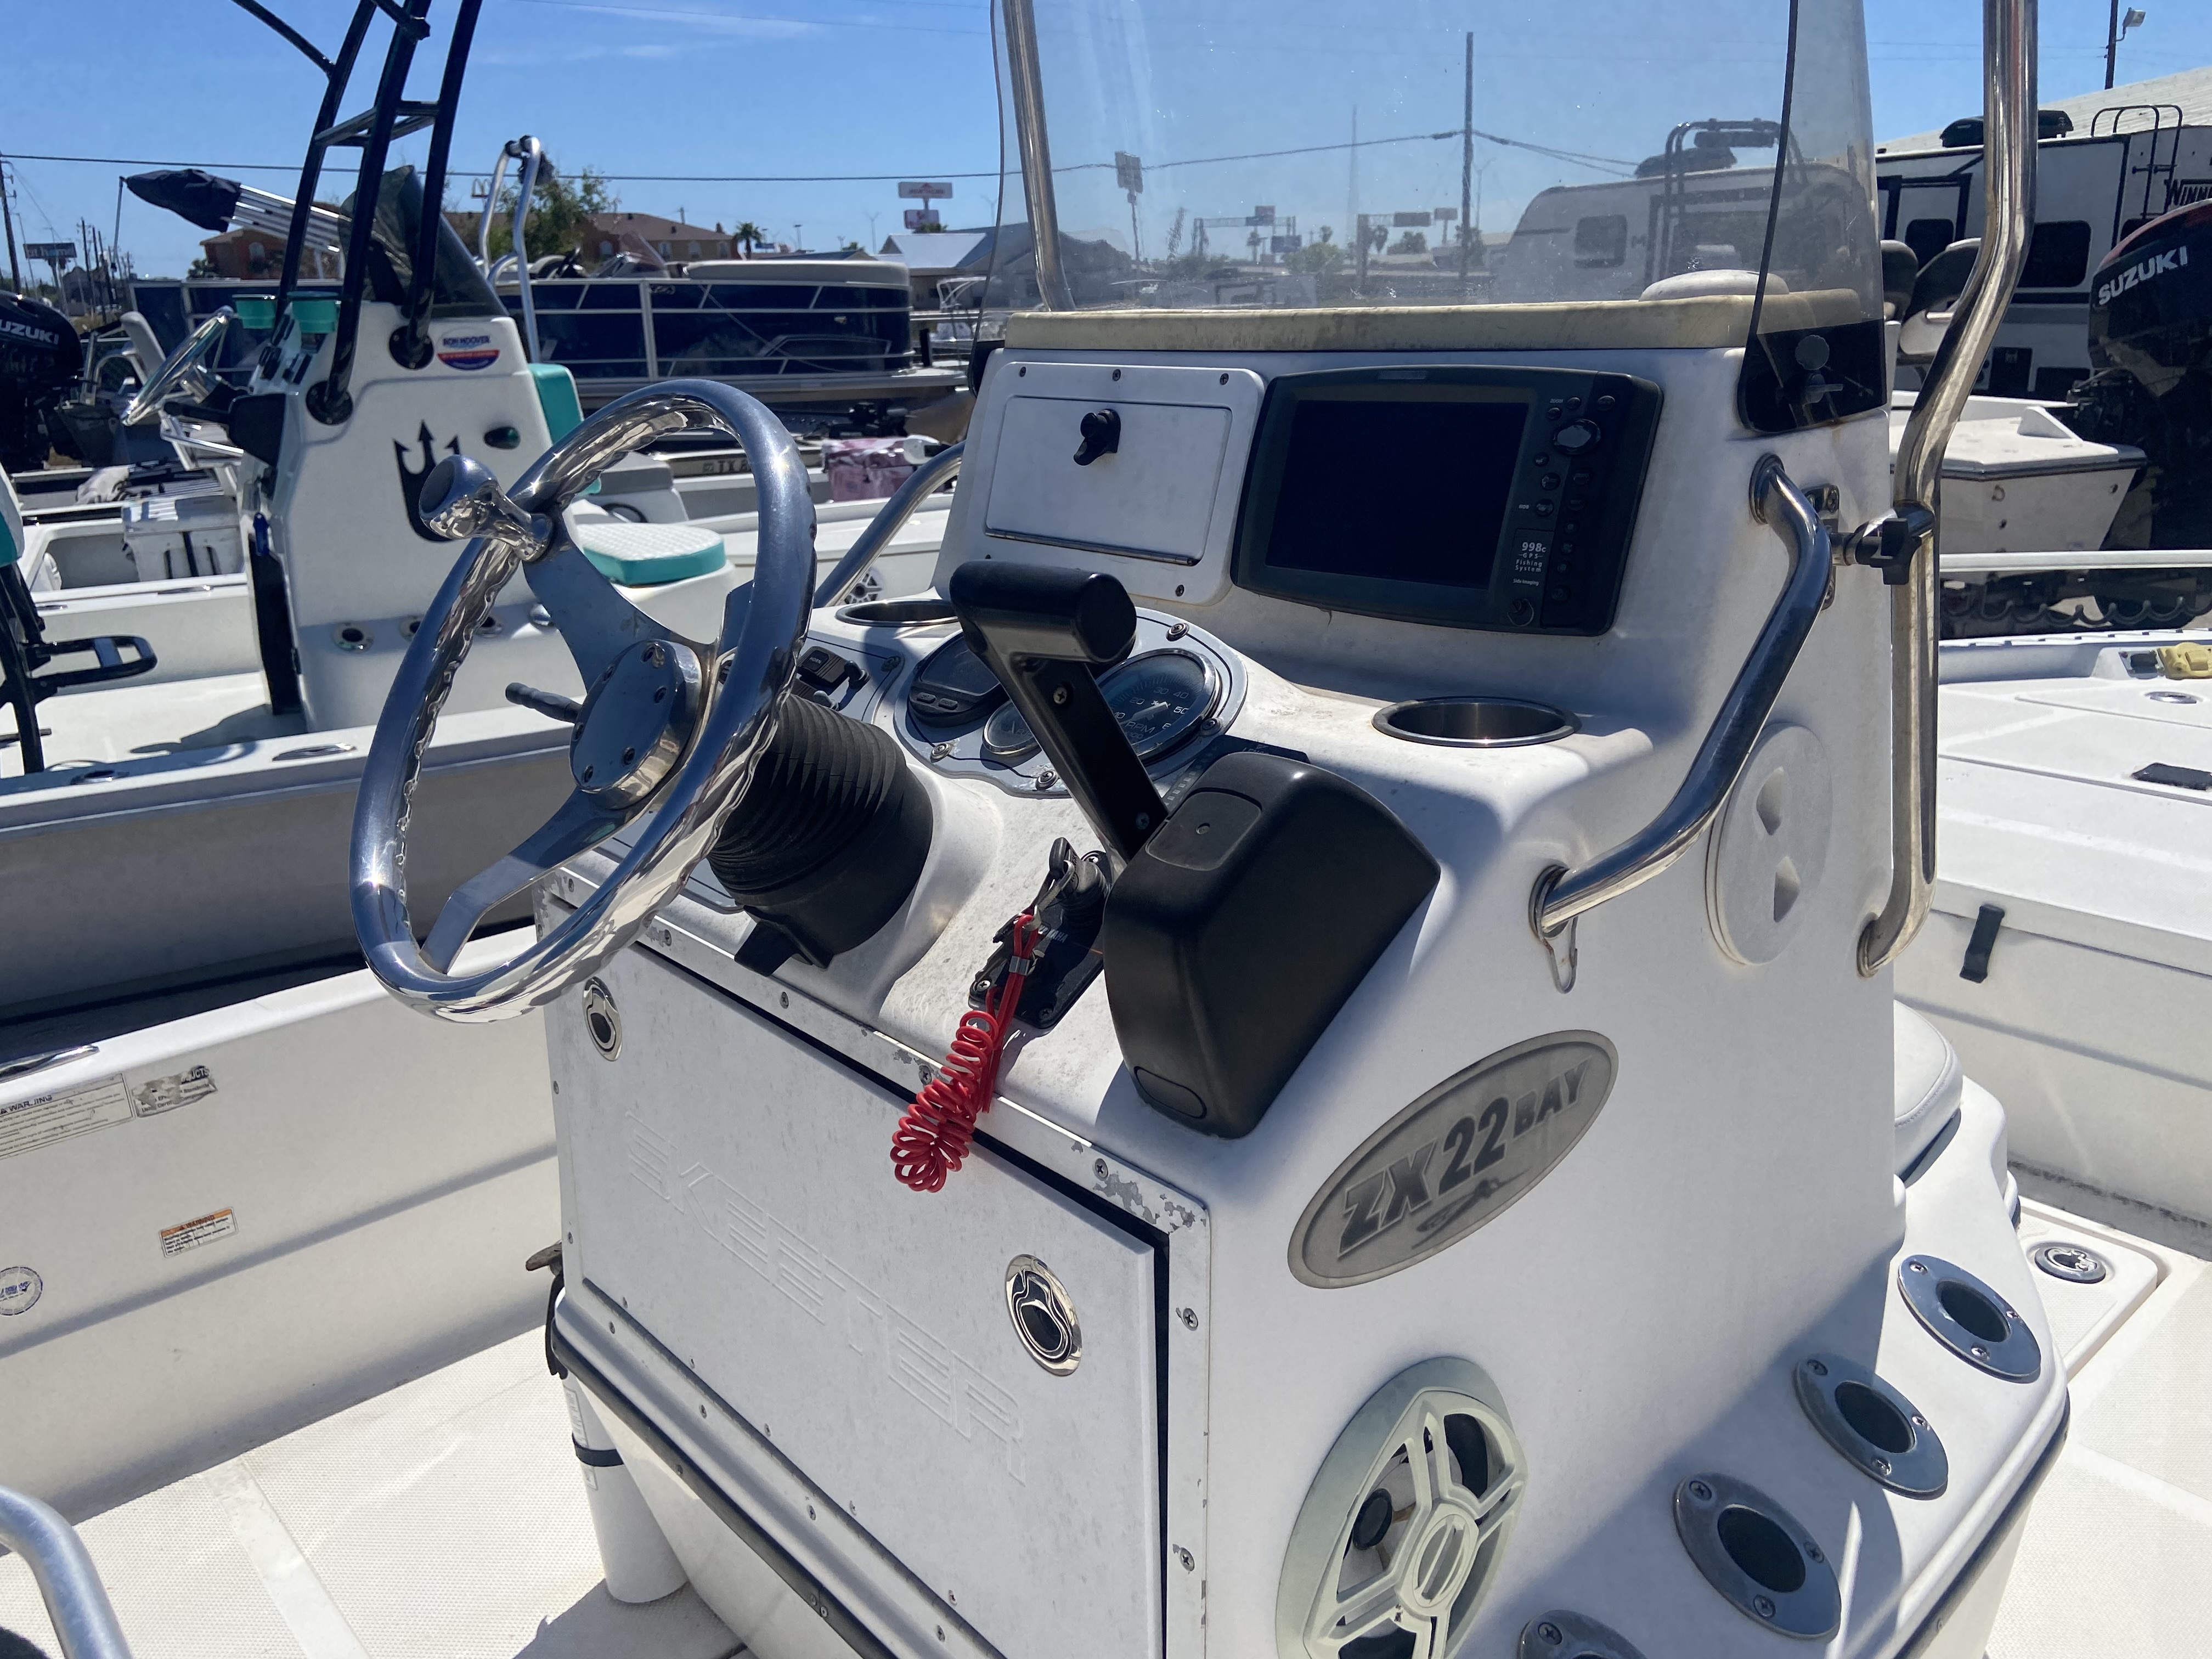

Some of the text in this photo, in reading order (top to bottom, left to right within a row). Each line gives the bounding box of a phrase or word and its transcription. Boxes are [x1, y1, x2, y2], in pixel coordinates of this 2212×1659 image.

[2098, 245, 2188, 305] SUZUKI
[0, 319, 59, 345] UZUKI
[1522, 541, 1547, 552] 998c
[1516, 559, 1542, 567] Fishing
[1153, 686, 1169, 695] 30
[1129, 697, 1145, 705] 20
[1114, 711, 1126, 719] 10
[1125, 721, 1156, 734] RPM
[1513, 1054, 1593, 1140] BAY
[624, 1110, 1026, 1487] SKEETER
